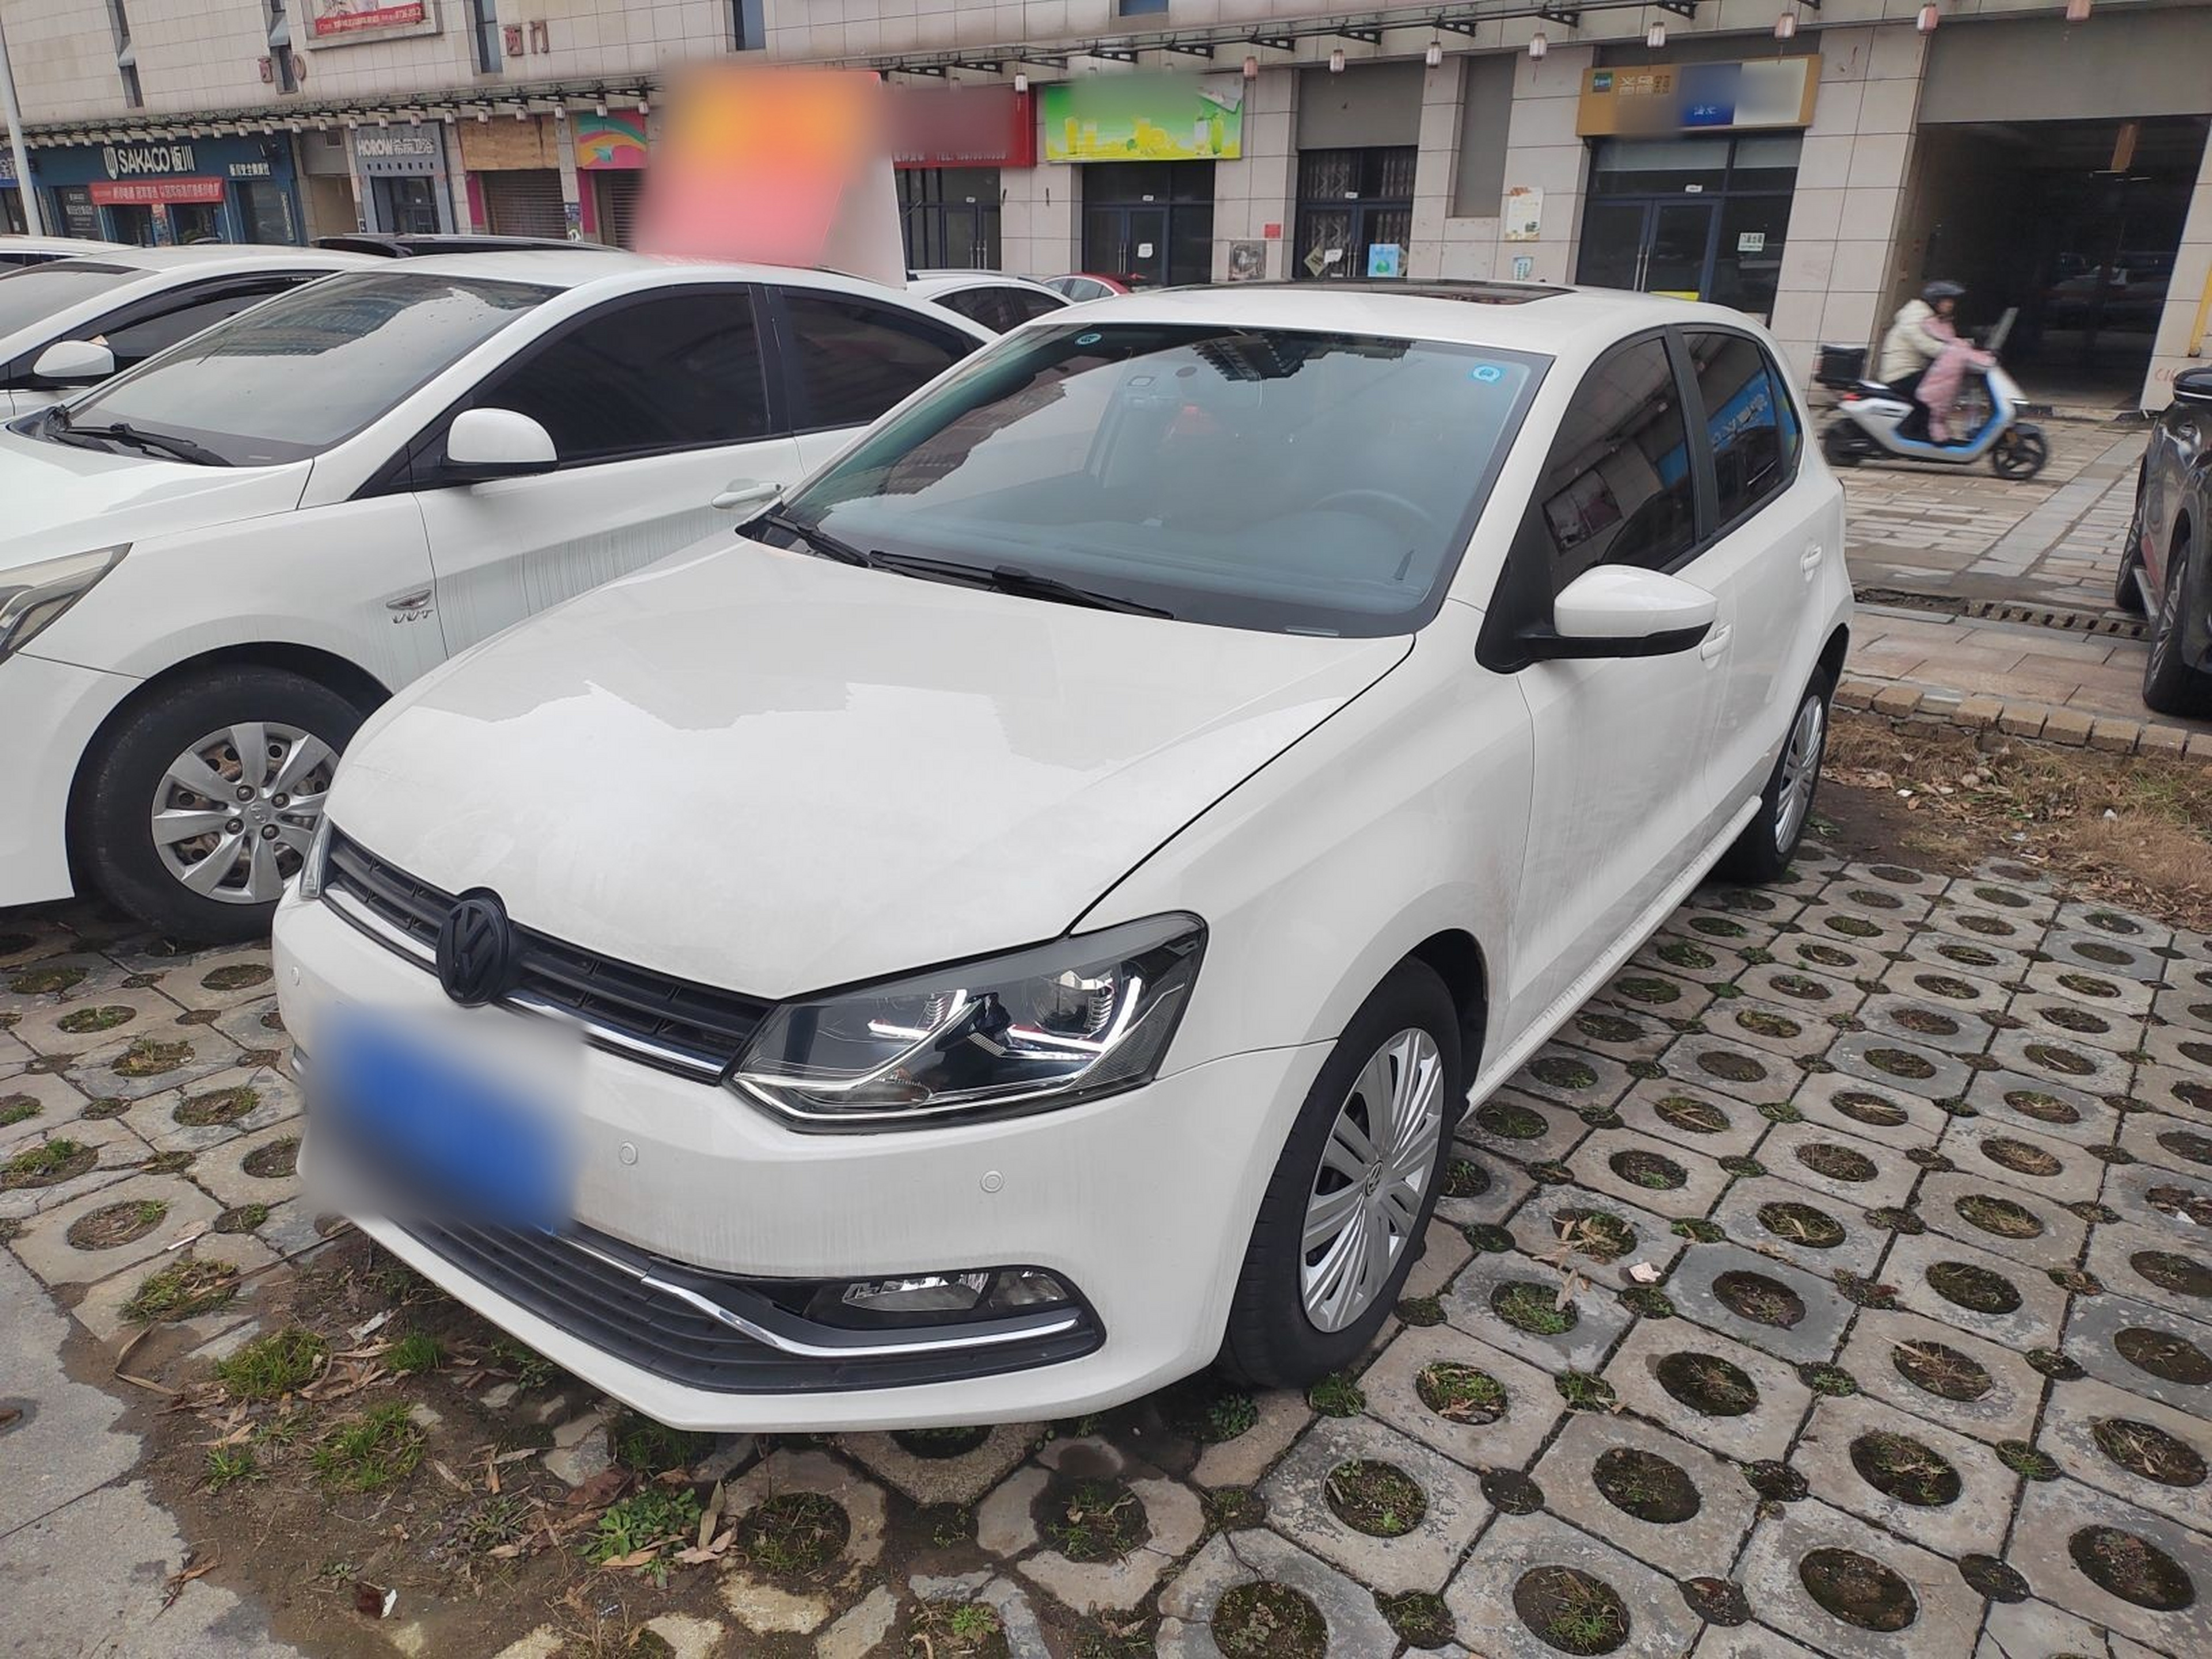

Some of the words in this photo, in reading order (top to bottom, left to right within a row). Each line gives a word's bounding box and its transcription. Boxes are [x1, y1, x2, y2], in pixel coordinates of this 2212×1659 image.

[118, 147, 170, 173] SAKACO
[171, 145, 195, 172] 板川
[357, 138, 393, 157] HOROW
